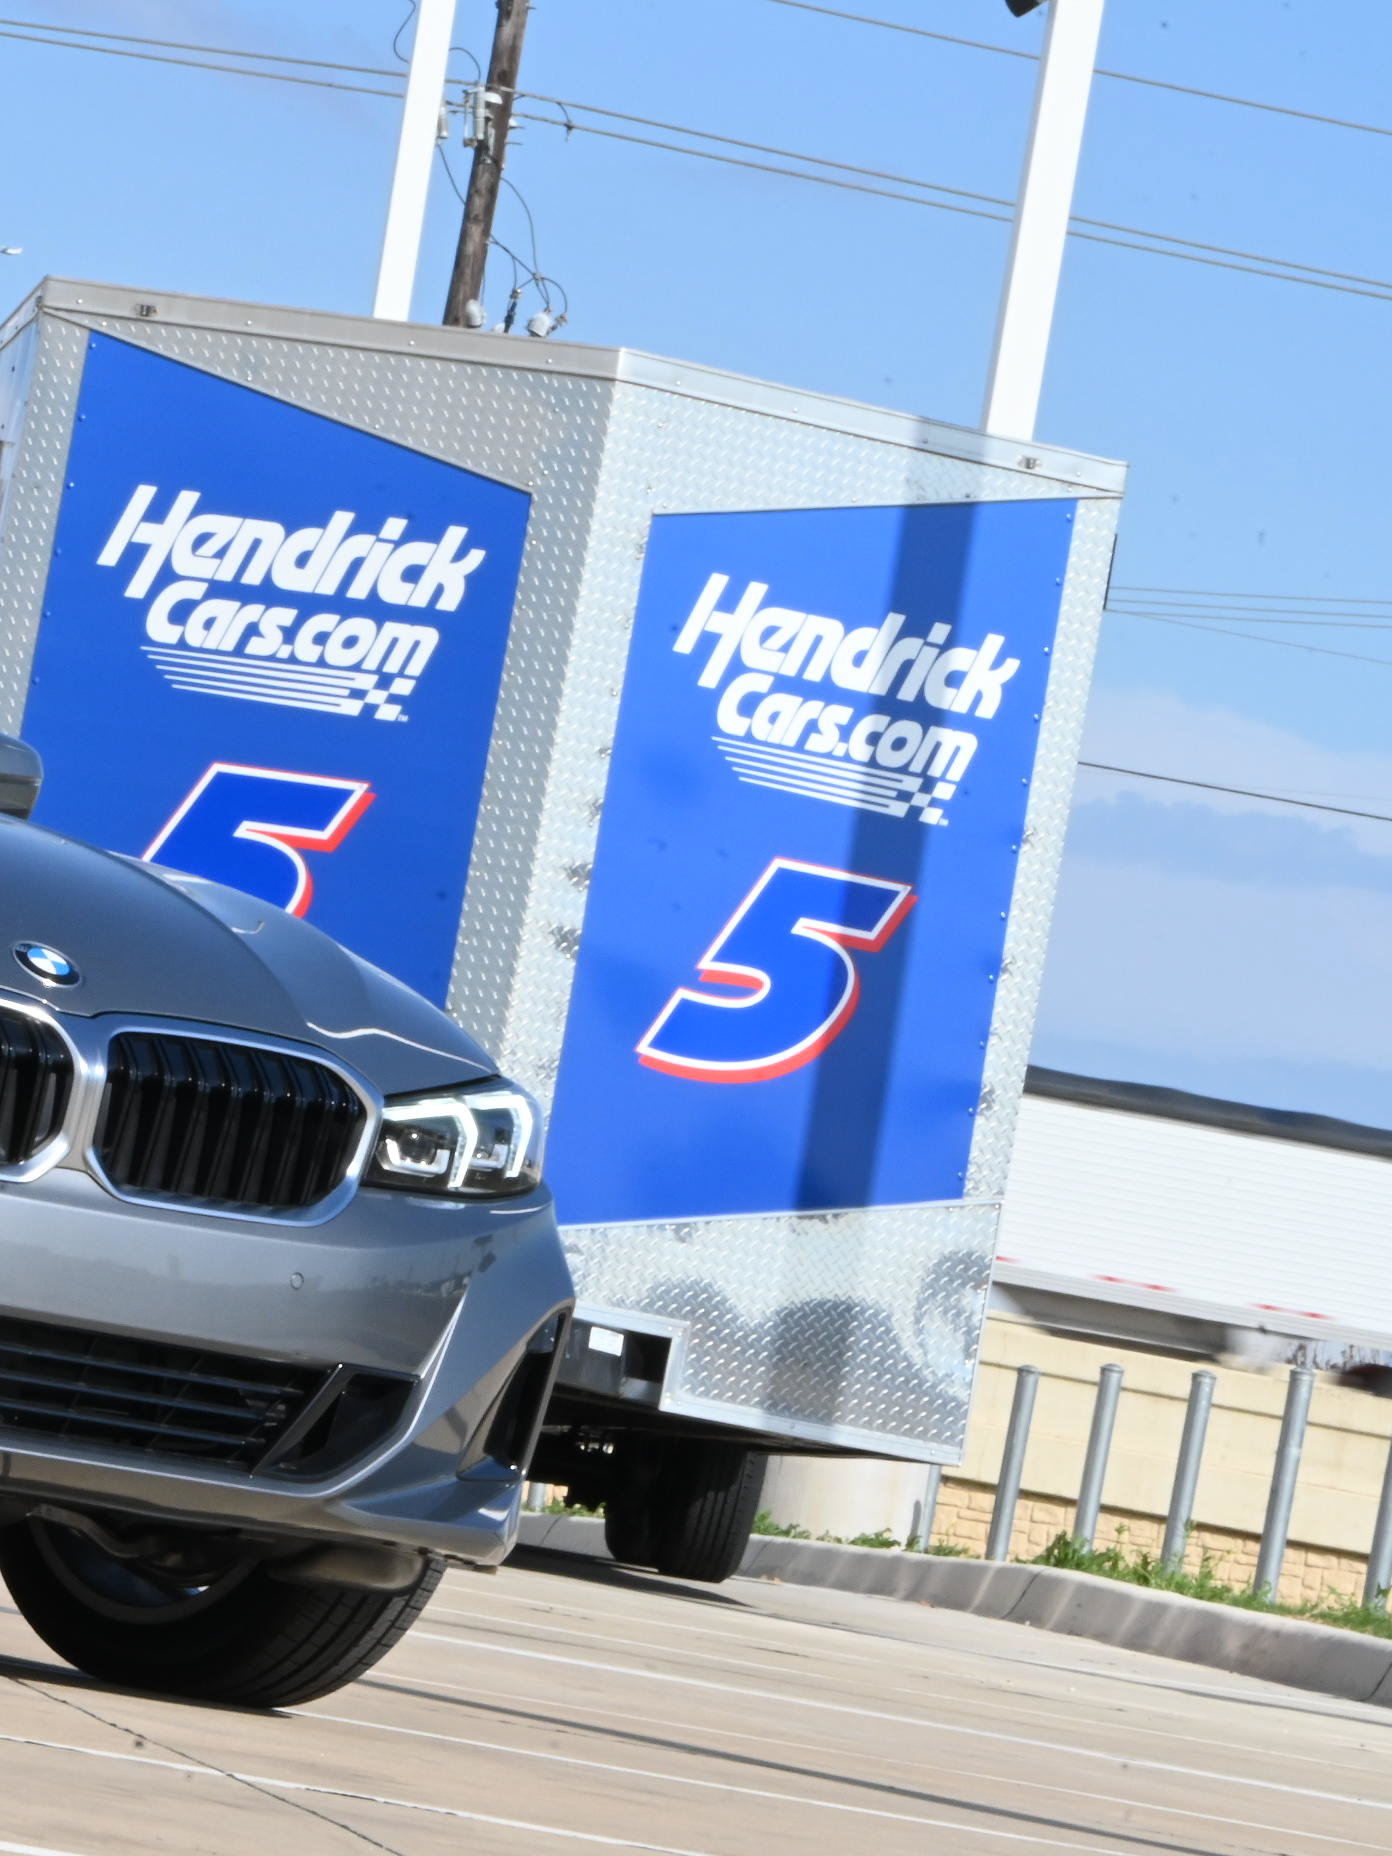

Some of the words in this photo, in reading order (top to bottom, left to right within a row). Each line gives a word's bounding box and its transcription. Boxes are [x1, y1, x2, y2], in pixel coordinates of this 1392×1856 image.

[97, 485, 486, 611] Hendrick
[146, 580, 439, 676] Cars.com
[672, 573, 1020, 719] Hendrick
[716, 673, 978, 782] Cars.com
[141, 762, 376, 919] 5
[634, 856, 918, 1084] 5
